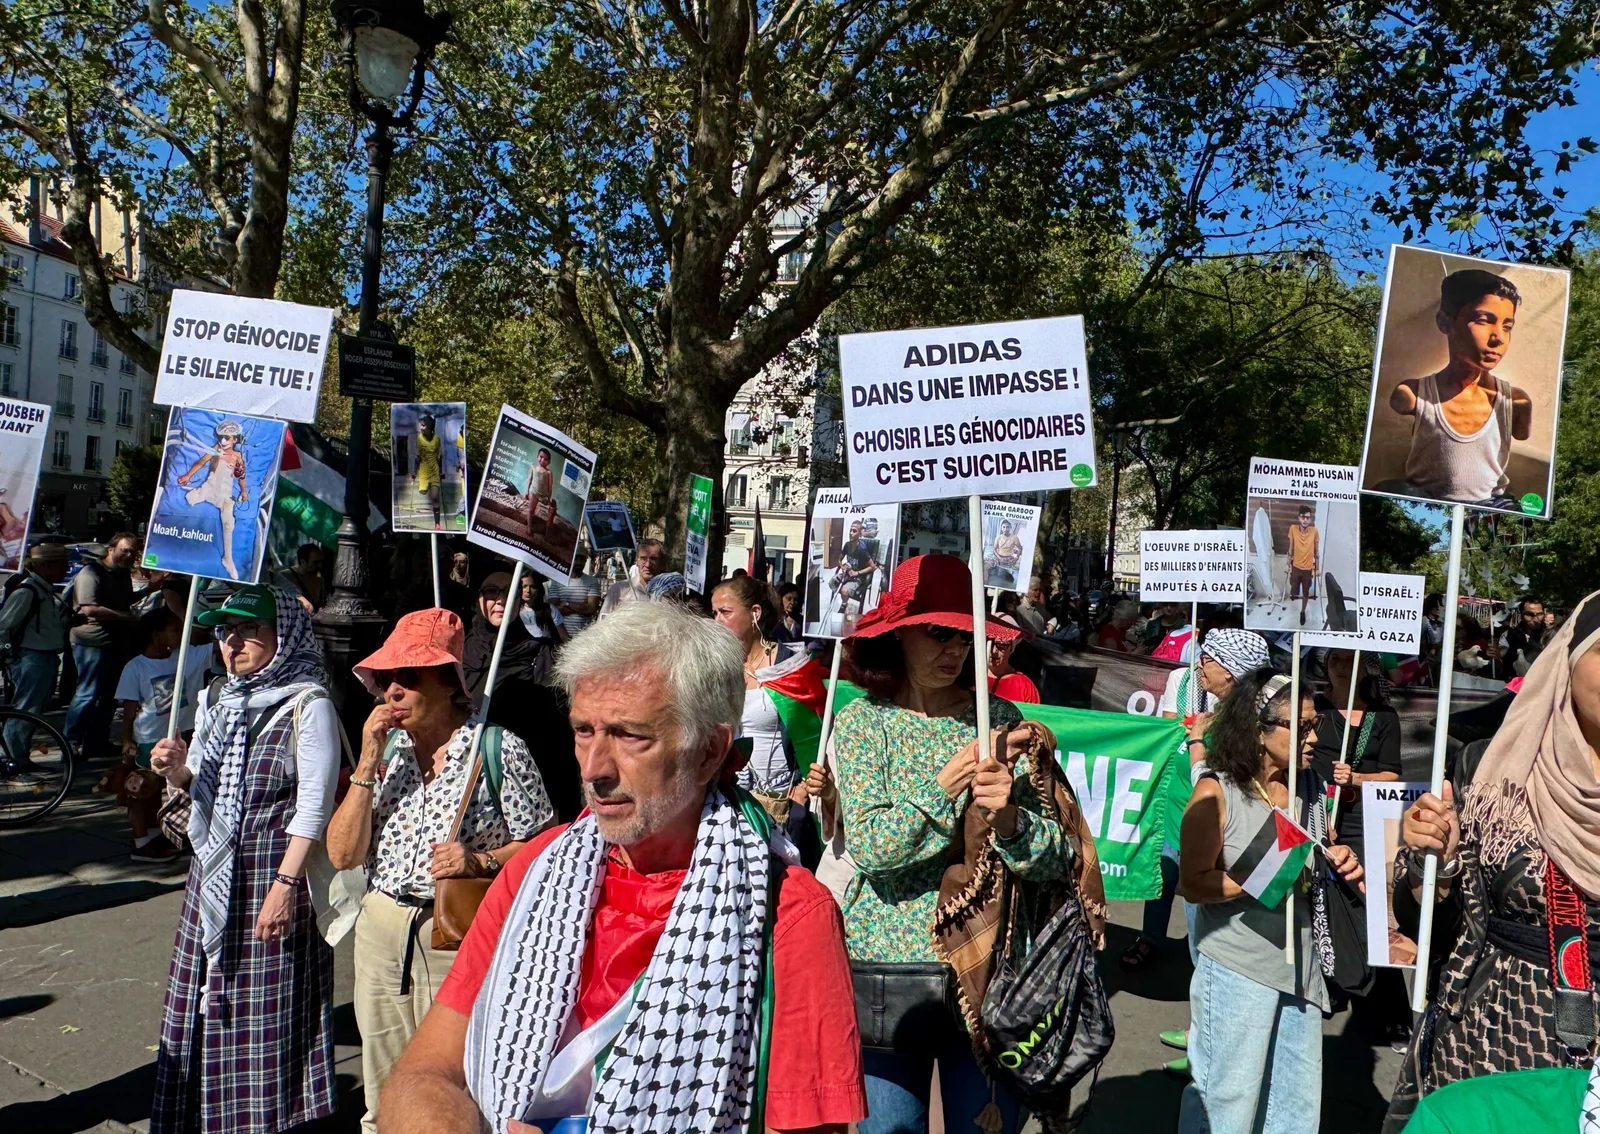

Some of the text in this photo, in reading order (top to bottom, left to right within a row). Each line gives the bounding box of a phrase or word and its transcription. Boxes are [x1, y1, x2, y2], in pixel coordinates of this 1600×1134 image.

[172, 318, 321, 354] STOP GÉNOCIDE
[903, 337, 1022, 369] ADIDAS
[165, 354, 314, 391] LE SILENCE TUE !
[852, 367, 1079, 408] DANS UNE IMPASSE !
[0, 420, 34, 434] IANT
[853, 413, 1085, 454] CHOISIR LES GÉNOCIDAIRES
[500, 440, 517, 451] Israel
[876, 448, 1067, 485] C'EST SUICIDAIRE
[1254, 464, 1315, 477] MOHAMMED
[1291, 480, 1318, 489] 21 ANS
[818, 494, 852, 504] ATALLA
[496, 534, 530, 550] occupation
[530, 548, 549, 561] robbed
[549, 559, 557, 568] my
[1144, 543, 1190, 551] L'OEUVRE
[1194, 540, 1238, 551] D'ISRAËL
[1144, 562, 1243, 571] DES MILLIERS D'ENFANTS
[1145, 580, 1242, 592] AMPUTÉS À GAZA
[1363, 582, 1414, 599] D'ISRAËL
[1367, 608, 1417, 621] D'ENFANTS
[1367, 627, 1376, 639] À
[1380, 631, 1414, 643] GAZA
